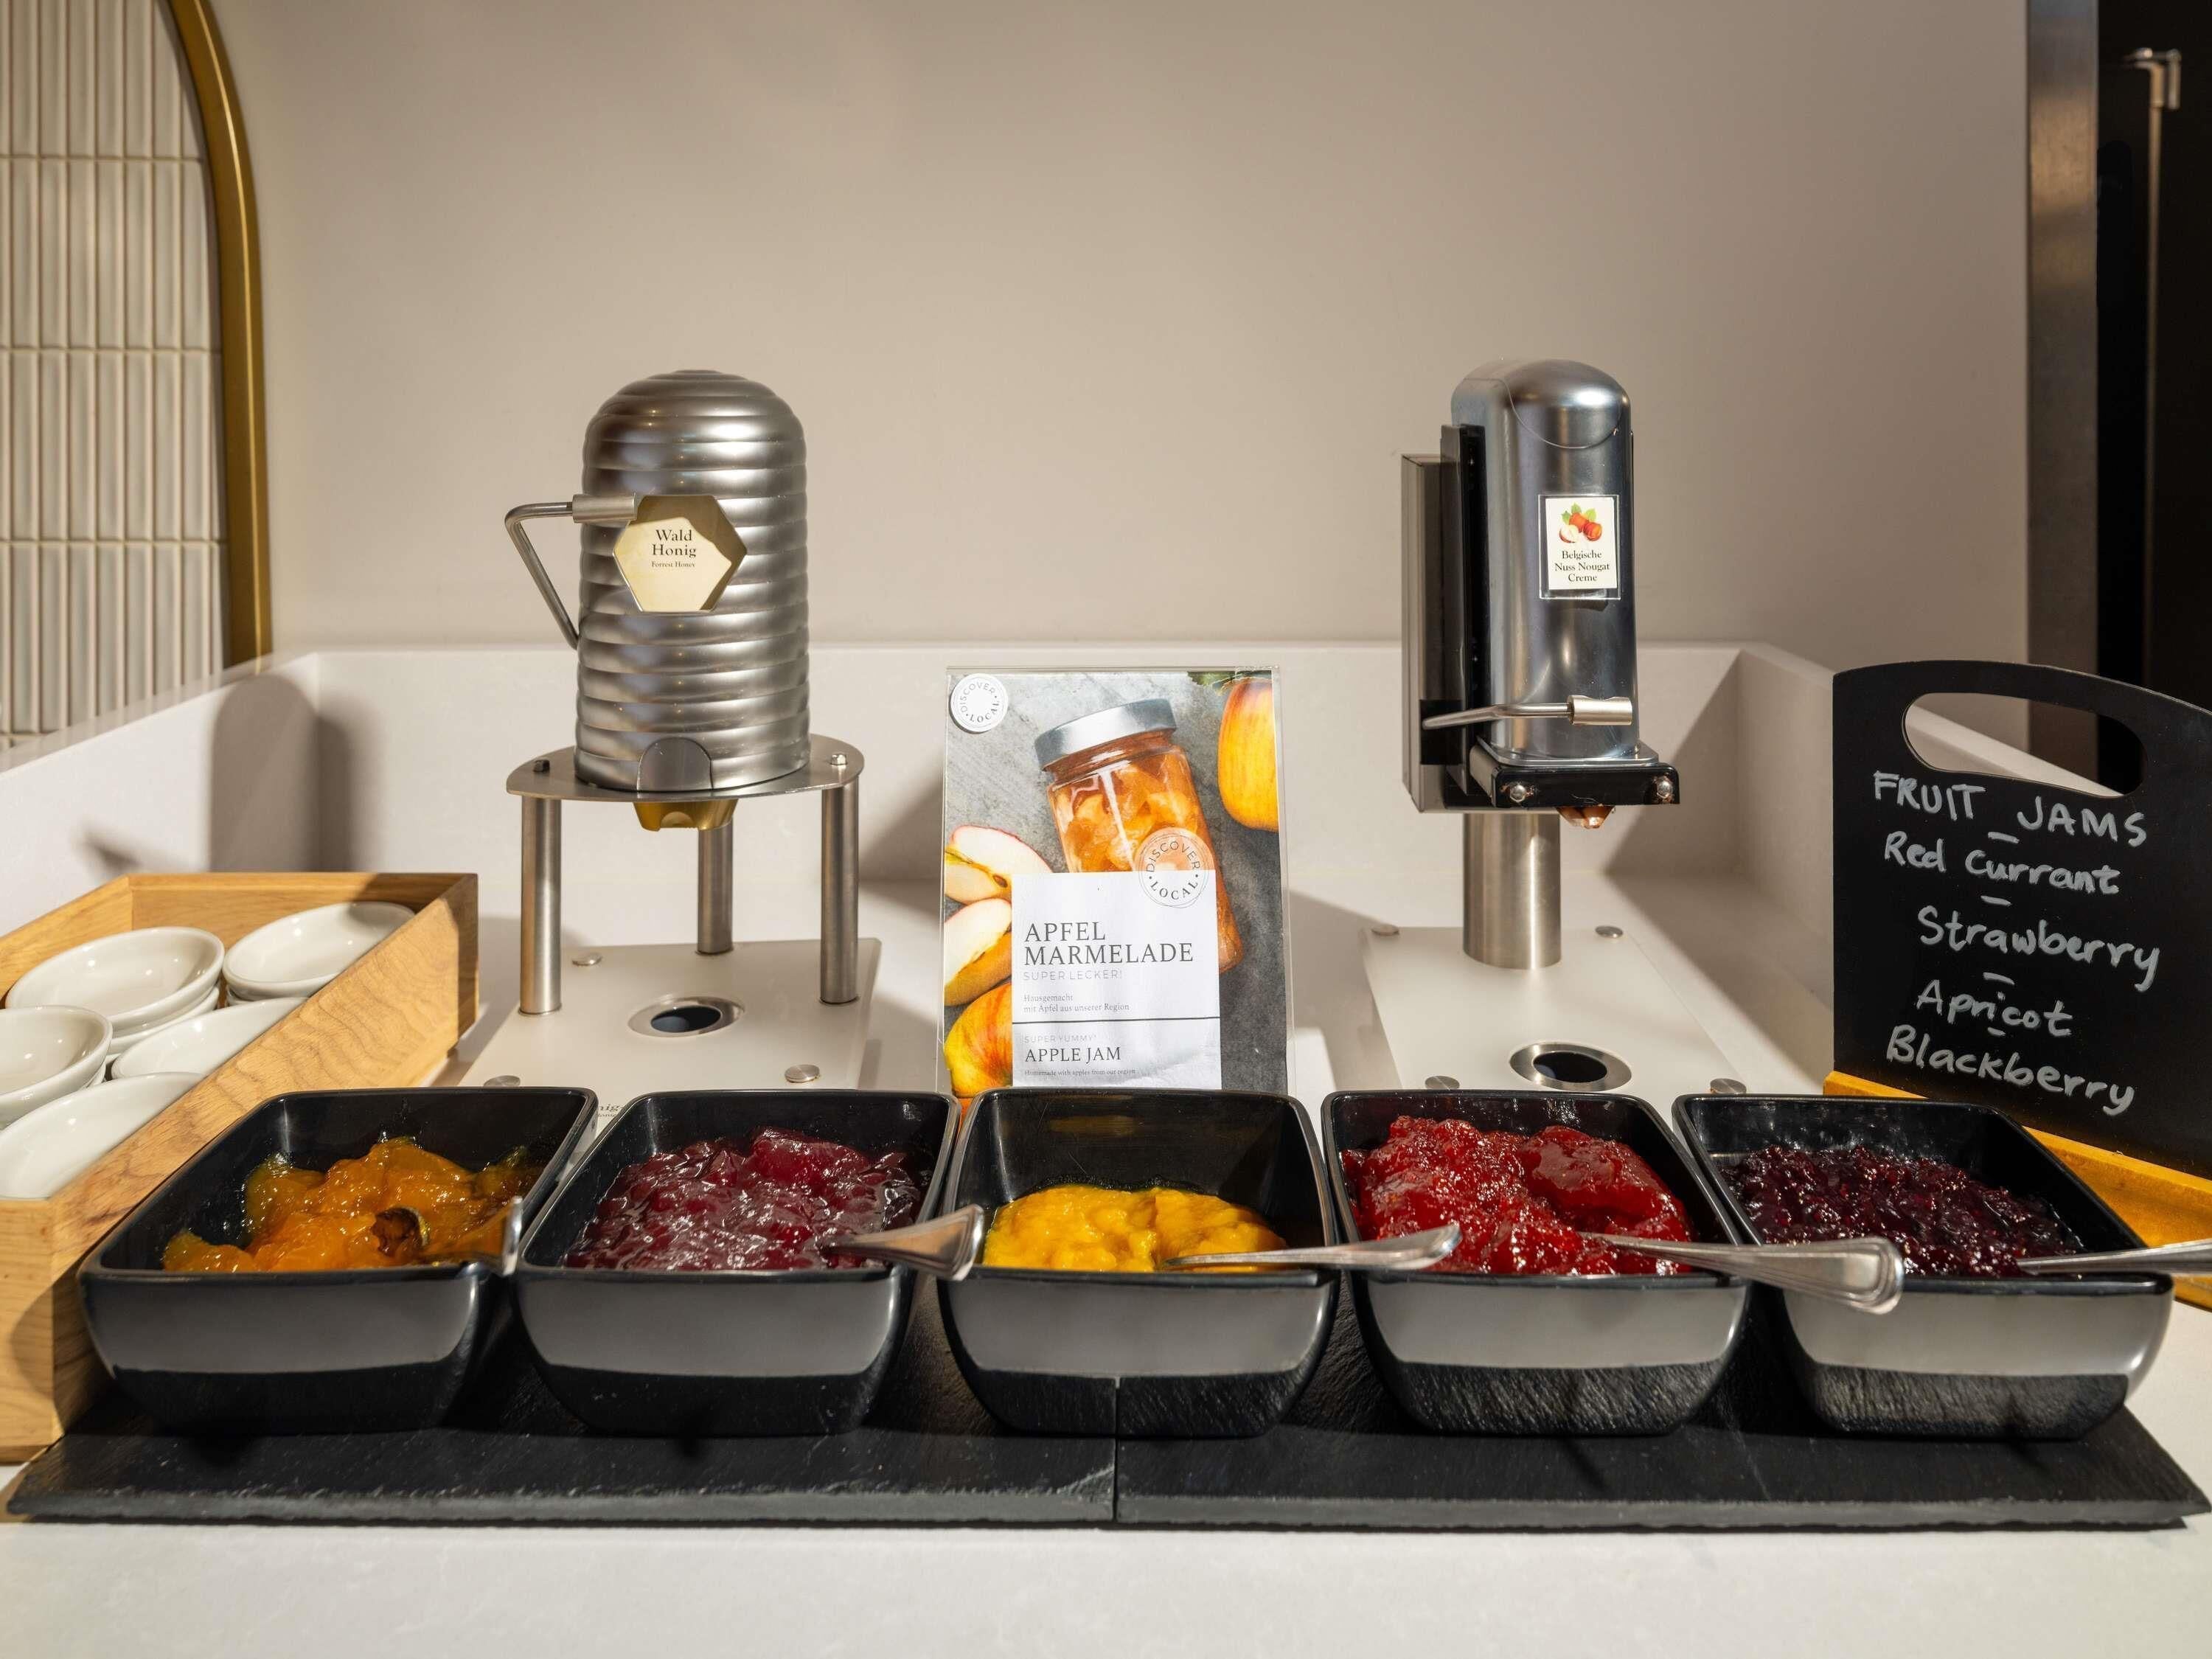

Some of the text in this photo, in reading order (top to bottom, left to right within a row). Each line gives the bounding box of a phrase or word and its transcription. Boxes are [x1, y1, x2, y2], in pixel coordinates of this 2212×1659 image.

[655, 529, 692, 541] Wald
[652, 543, 697, 557] Honig
[1562, 550, 1602, 560] Belgische
[675, 560, 695, 568] Honey
[1554, 562, 1610, 572] Nuss Nougat
[1568, 573, 1598, 582] Creme
[959, 681, 996, 713] DISCOVER
[970, 701, 1000, 723] LOCAL
[1873, 771, 2147, 847] FRUIT JAMS
[1146, 841, 1200, 872] DISCOVER
[1884, 830, 2120, 894] Red Currant
[1150, 880, 1198, 900] LOCAL
[1024, 921, 1106, 942] APFEL
[1024, 942, 1194, 966] MARMELADE
[1917, 905, 2161, 992] Strawberry
[1023, 969, 1123, 981] SUPER LECKER!
[1023, 993, 1074, 1002] Hausgemacht
[1104, 1003, 1130, 1012] Region
[1916, 979, 2073, 1037] Apricot
[1024, 1034, 1056, 1043] SUPER
[1025, 1046, 1121, 1064] APPLE JAM
[1886, 1024, 2136, 1116] Blackberry
